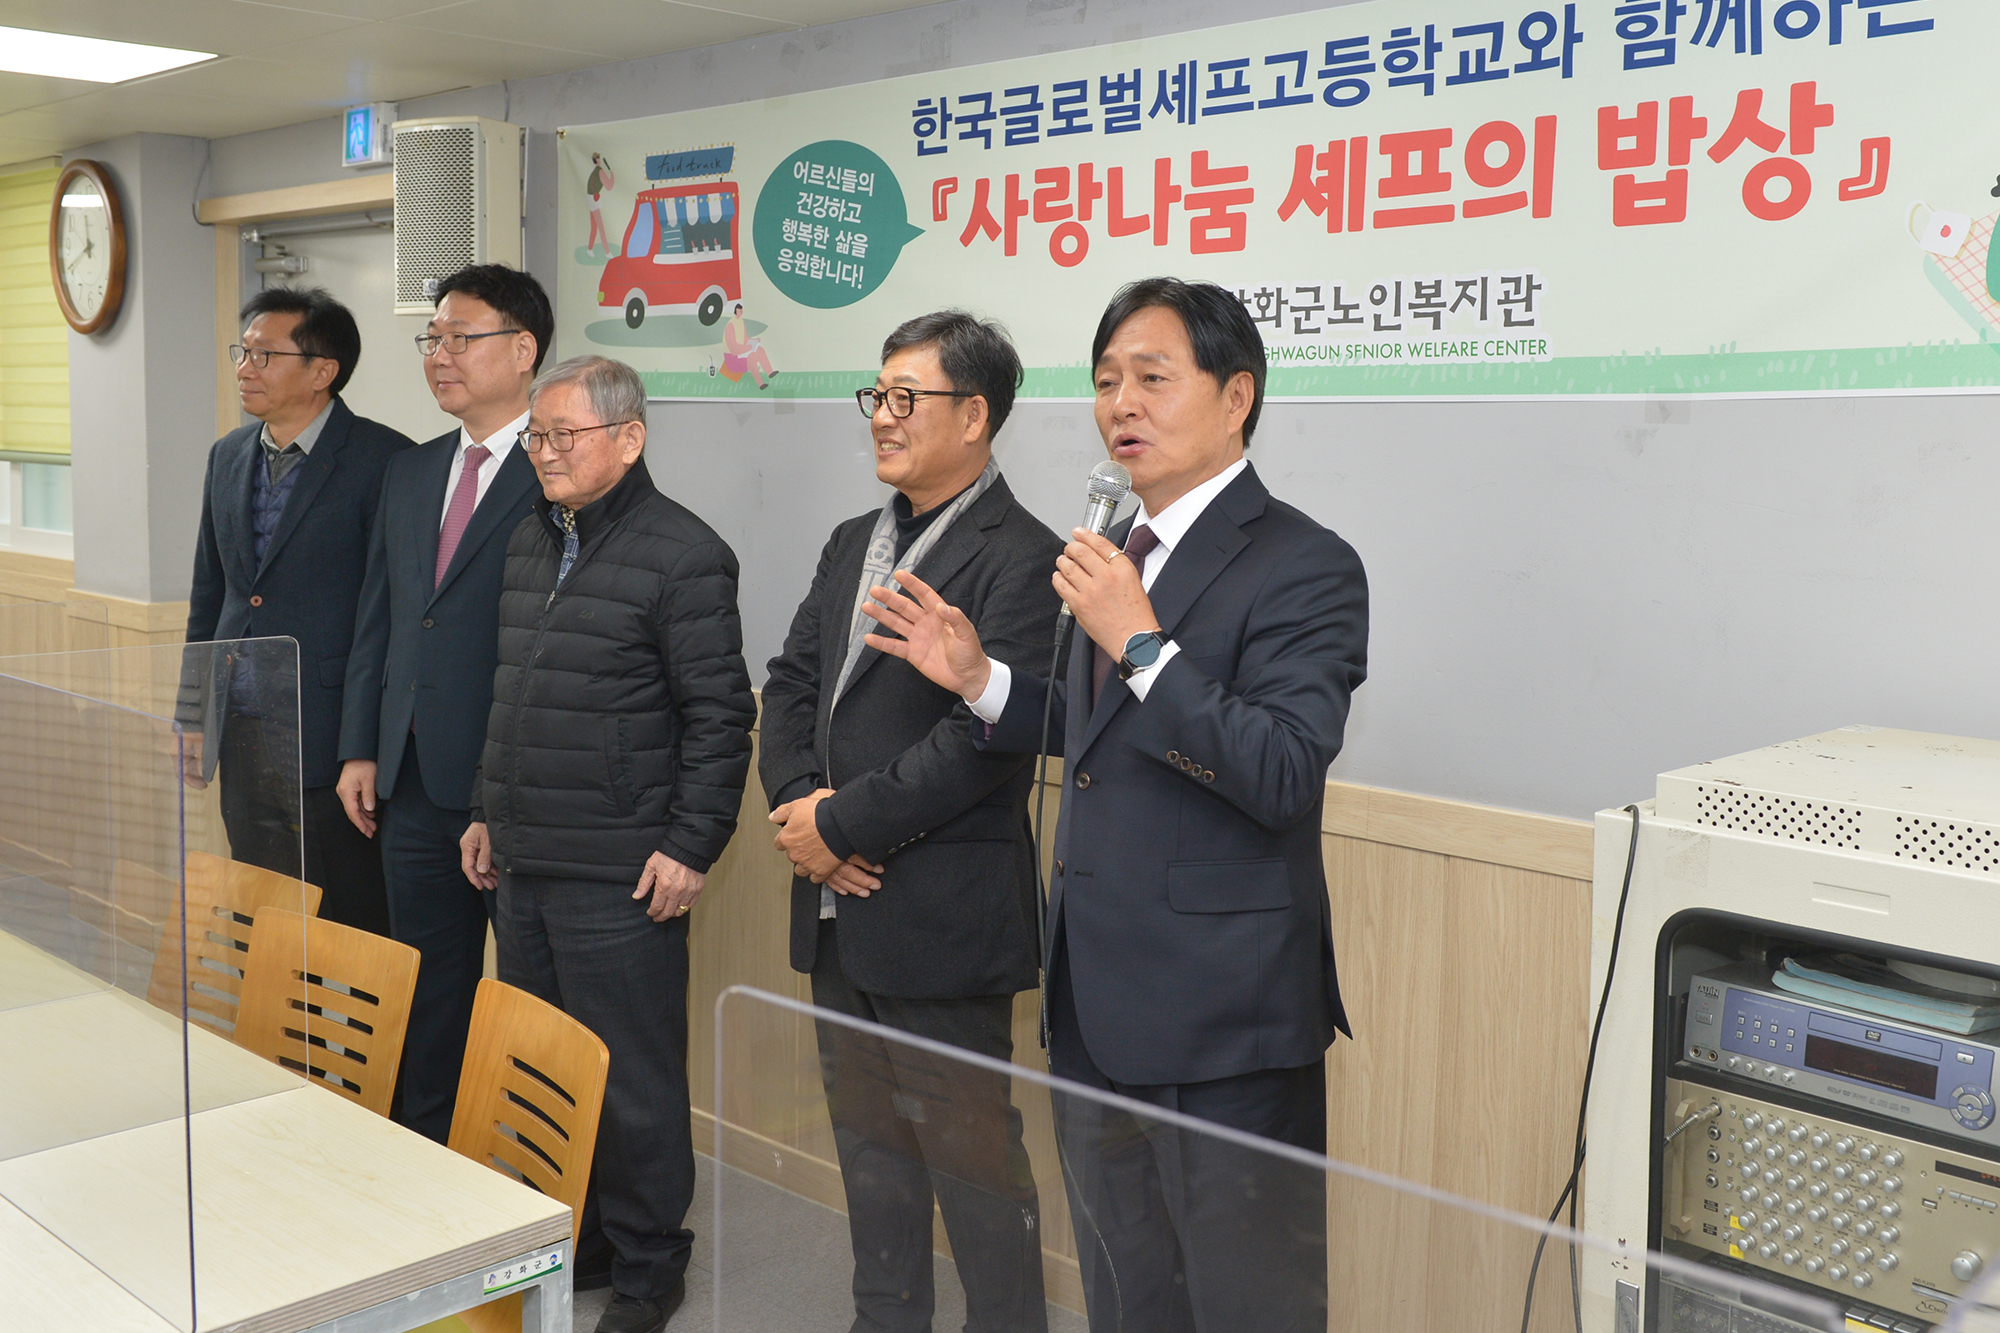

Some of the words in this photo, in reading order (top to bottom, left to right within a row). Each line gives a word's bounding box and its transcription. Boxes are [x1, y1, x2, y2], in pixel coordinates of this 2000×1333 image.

[912, 3, 1584, 156] 한국글로벌셰프고등학교와
[793, 161, 875, 197] 어르신들의
[1277, 114, 1558, 234] 셰프의
[796, 192, 862, 224] 건강하고
[782, 218, 830, 250] 행복한
[835, 230, 869, 259] 삶을
[777, 248, 864, 290] 응원합니다!
[1345, 343, 1402, 360] SENIOR
[1407, 341, 1479, 358] WELFARE
[1484, 339, 1548, 357] CENTER
